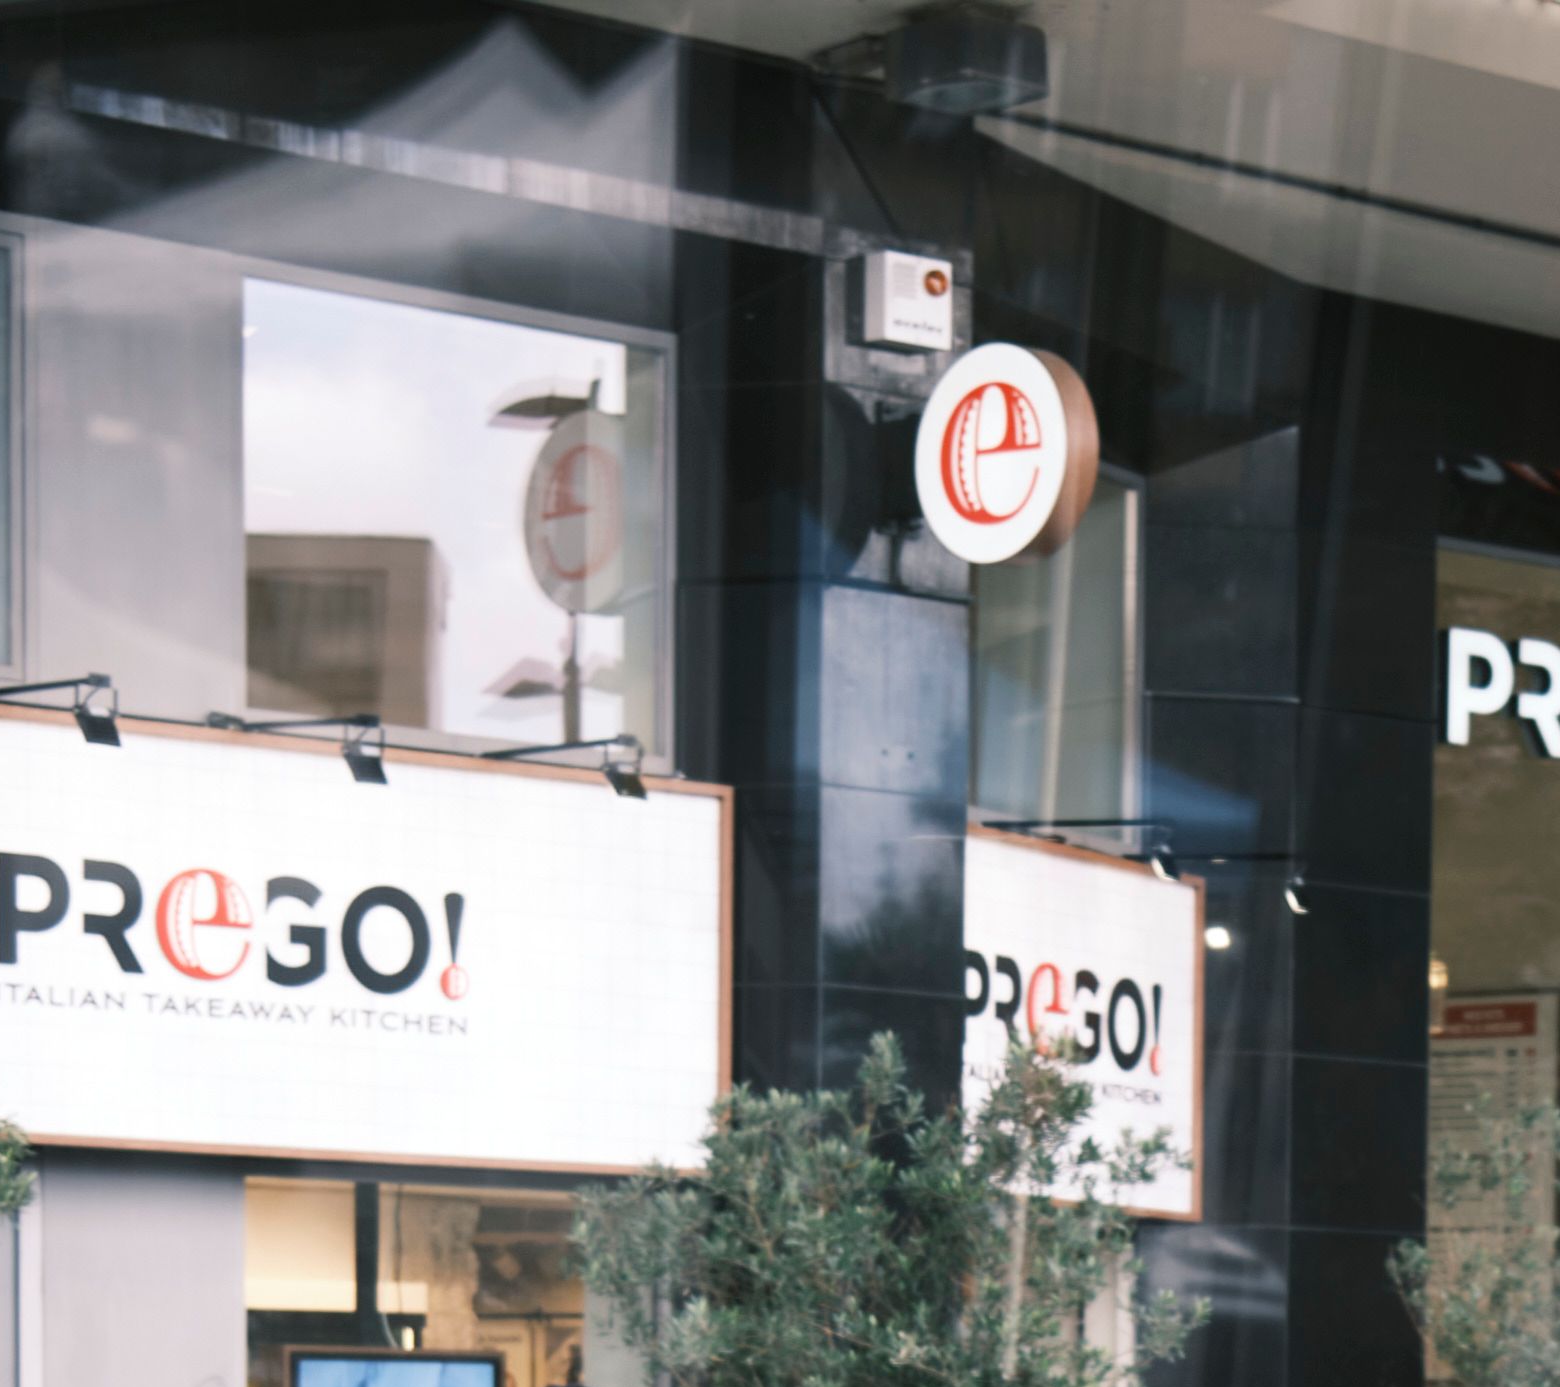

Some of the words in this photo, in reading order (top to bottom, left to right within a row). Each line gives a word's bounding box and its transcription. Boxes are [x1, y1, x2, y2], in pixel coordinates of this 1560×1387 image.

[940, 381, 1042, 525] e
[142, 992, 316, 1027] TAKEAWAY
[329, 1006, 470, 1037] KITCHEN
